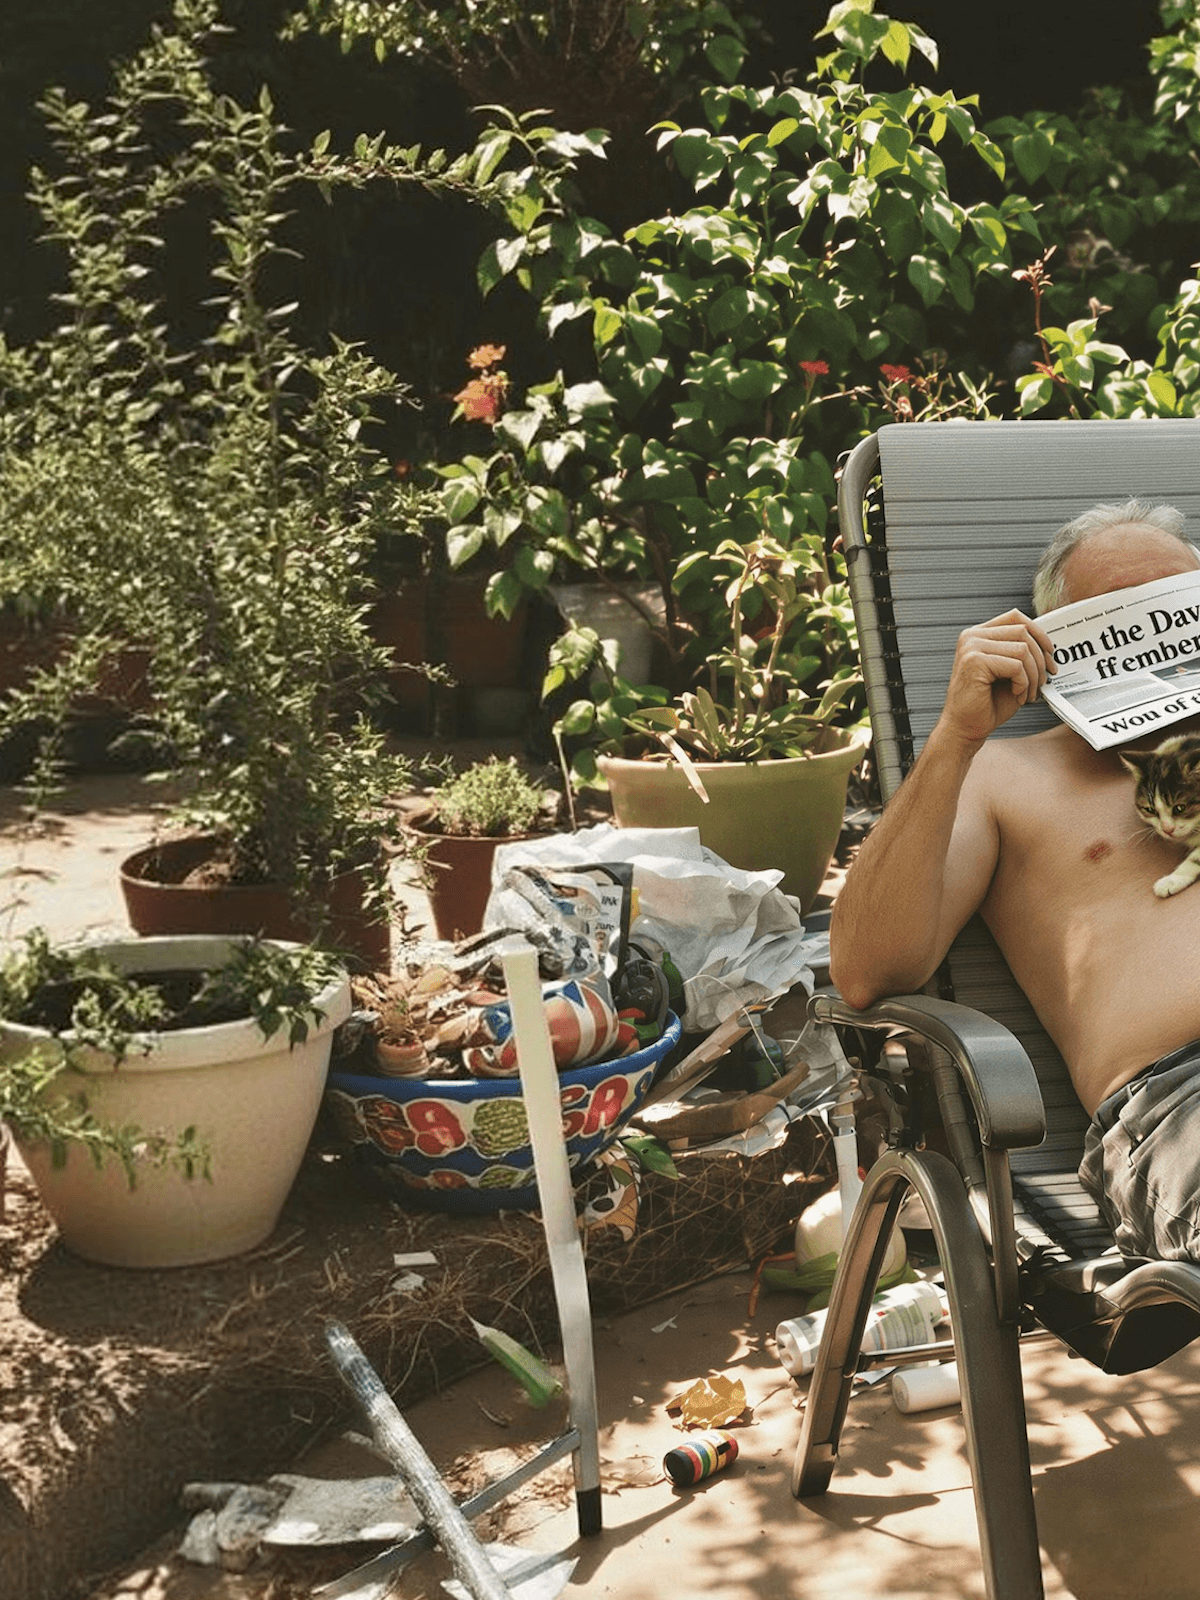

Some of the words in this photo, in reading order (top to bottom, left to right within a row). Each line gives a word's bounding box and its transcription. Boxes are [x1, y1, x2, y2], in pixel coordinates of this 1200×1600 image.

[1053, 640, 1098, 665] om
[1099, 624, 1145, 651] the
[1164, 697, 1190, 713] of
